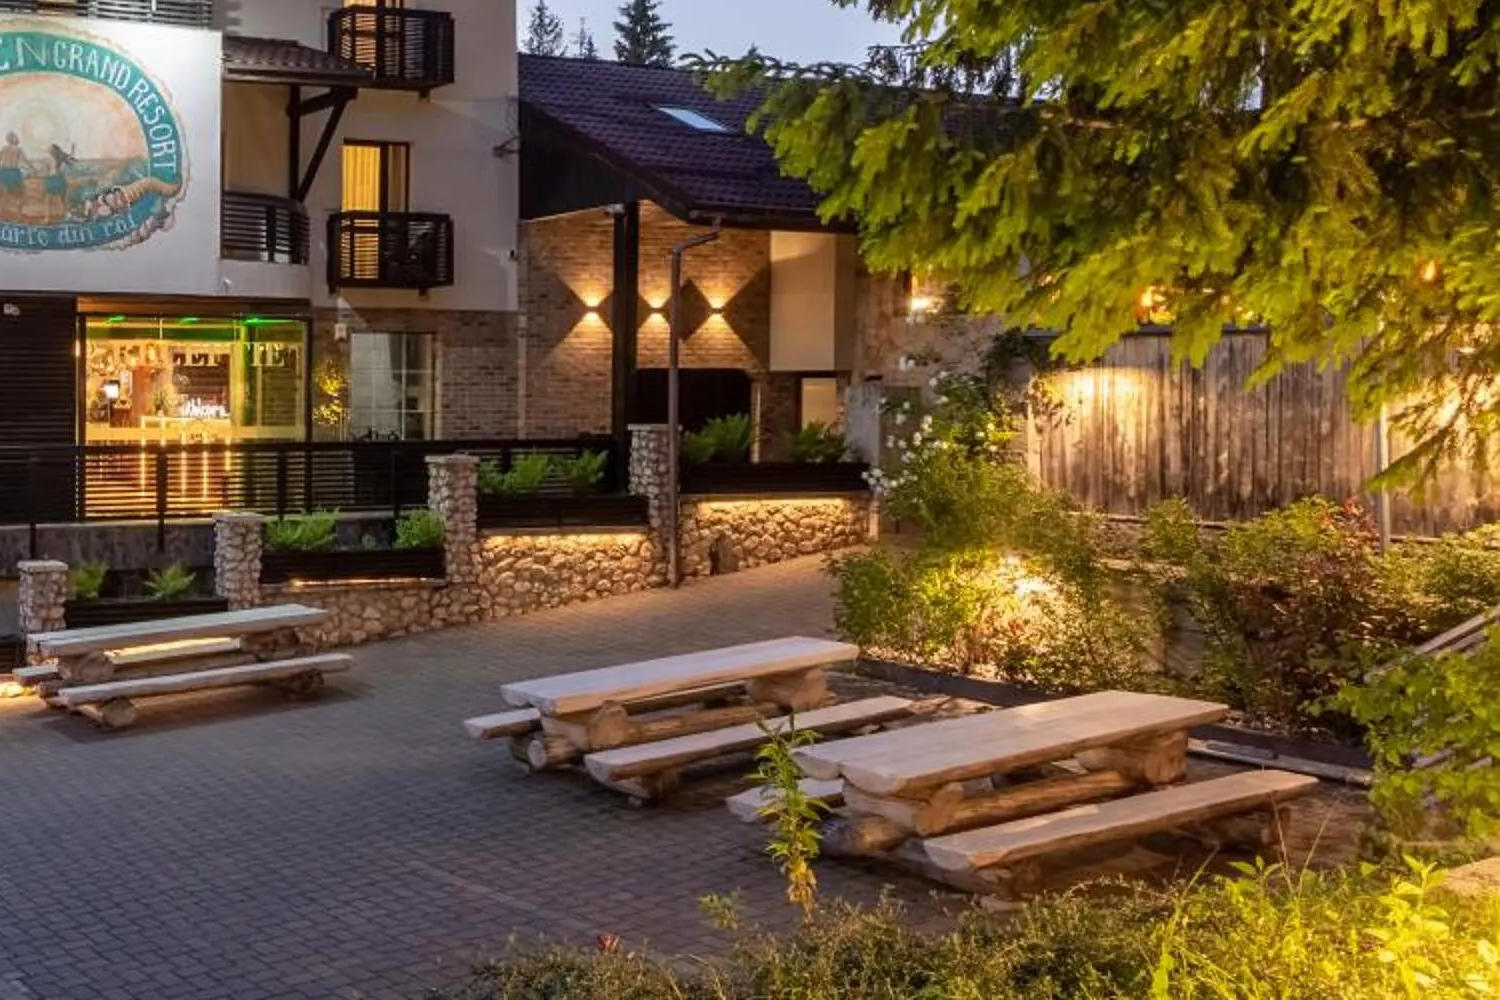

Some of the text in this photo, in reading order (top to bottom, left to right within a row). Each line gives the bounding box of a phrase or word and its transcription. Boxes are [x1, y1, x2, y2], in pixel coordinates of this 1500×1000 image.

[53, 39, 131, 90] GRAND
[127, 77, 177, 174] RESORT
[58, 222, 93, 244] din
[102, 213, 137, 237] rai
